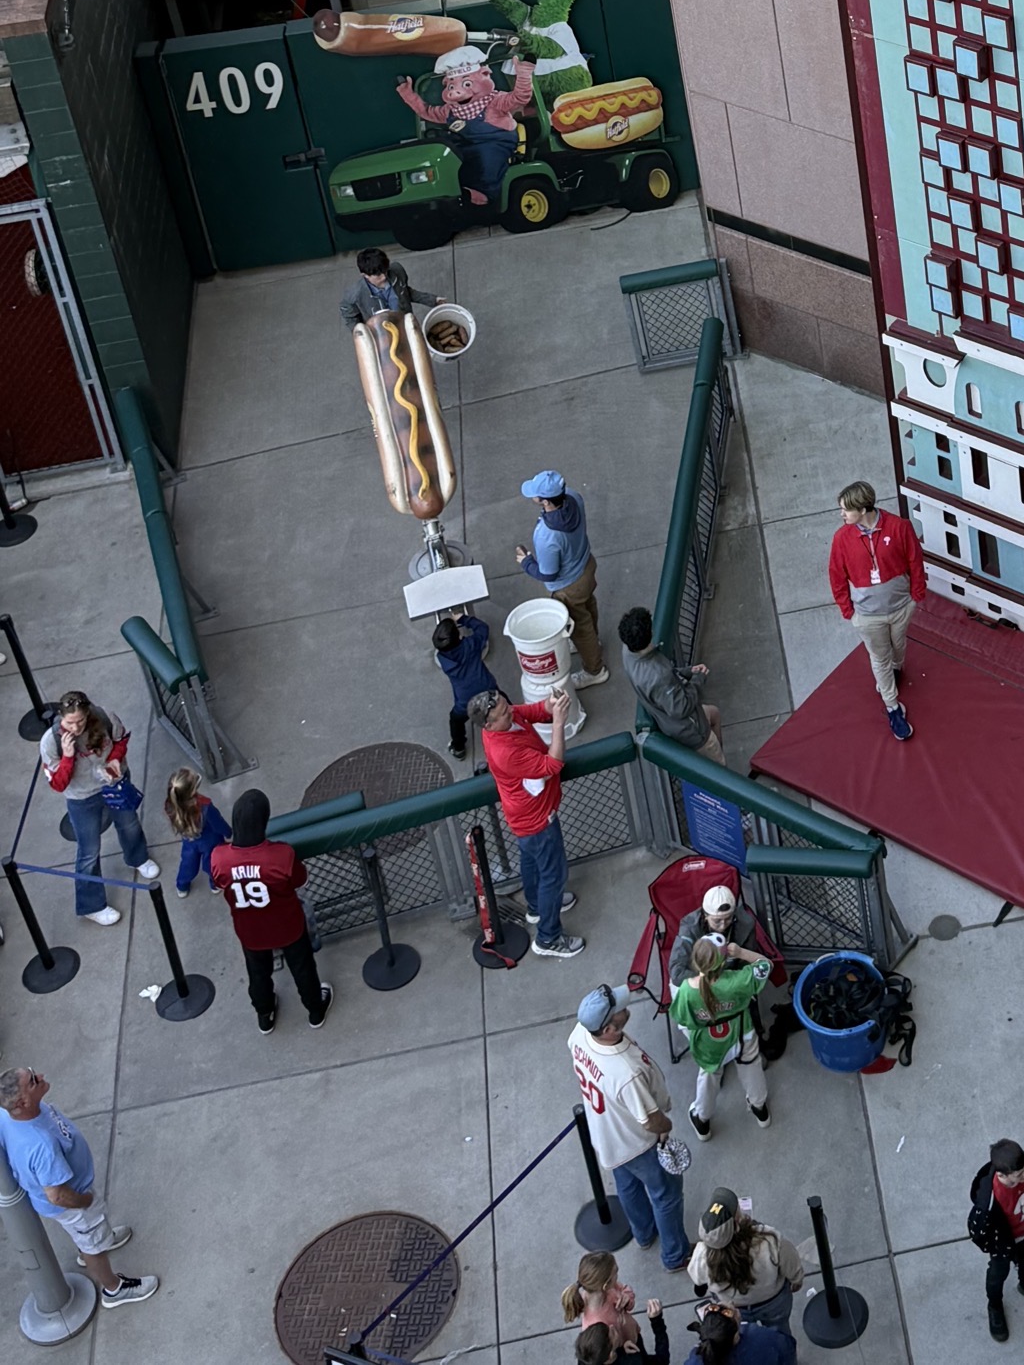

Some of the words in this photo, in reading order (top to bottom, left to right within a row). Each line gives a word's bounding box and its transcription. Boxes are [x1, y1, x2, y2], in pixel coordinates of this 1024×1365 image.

[186, 62, 284, 118] 409
[231, 864, 261, 881] KRUK
[230, 881, 271, 909] 19
[574, 1044, 605, 1084] SCHMIDT
[575, 1064, 606, 1115] 20
